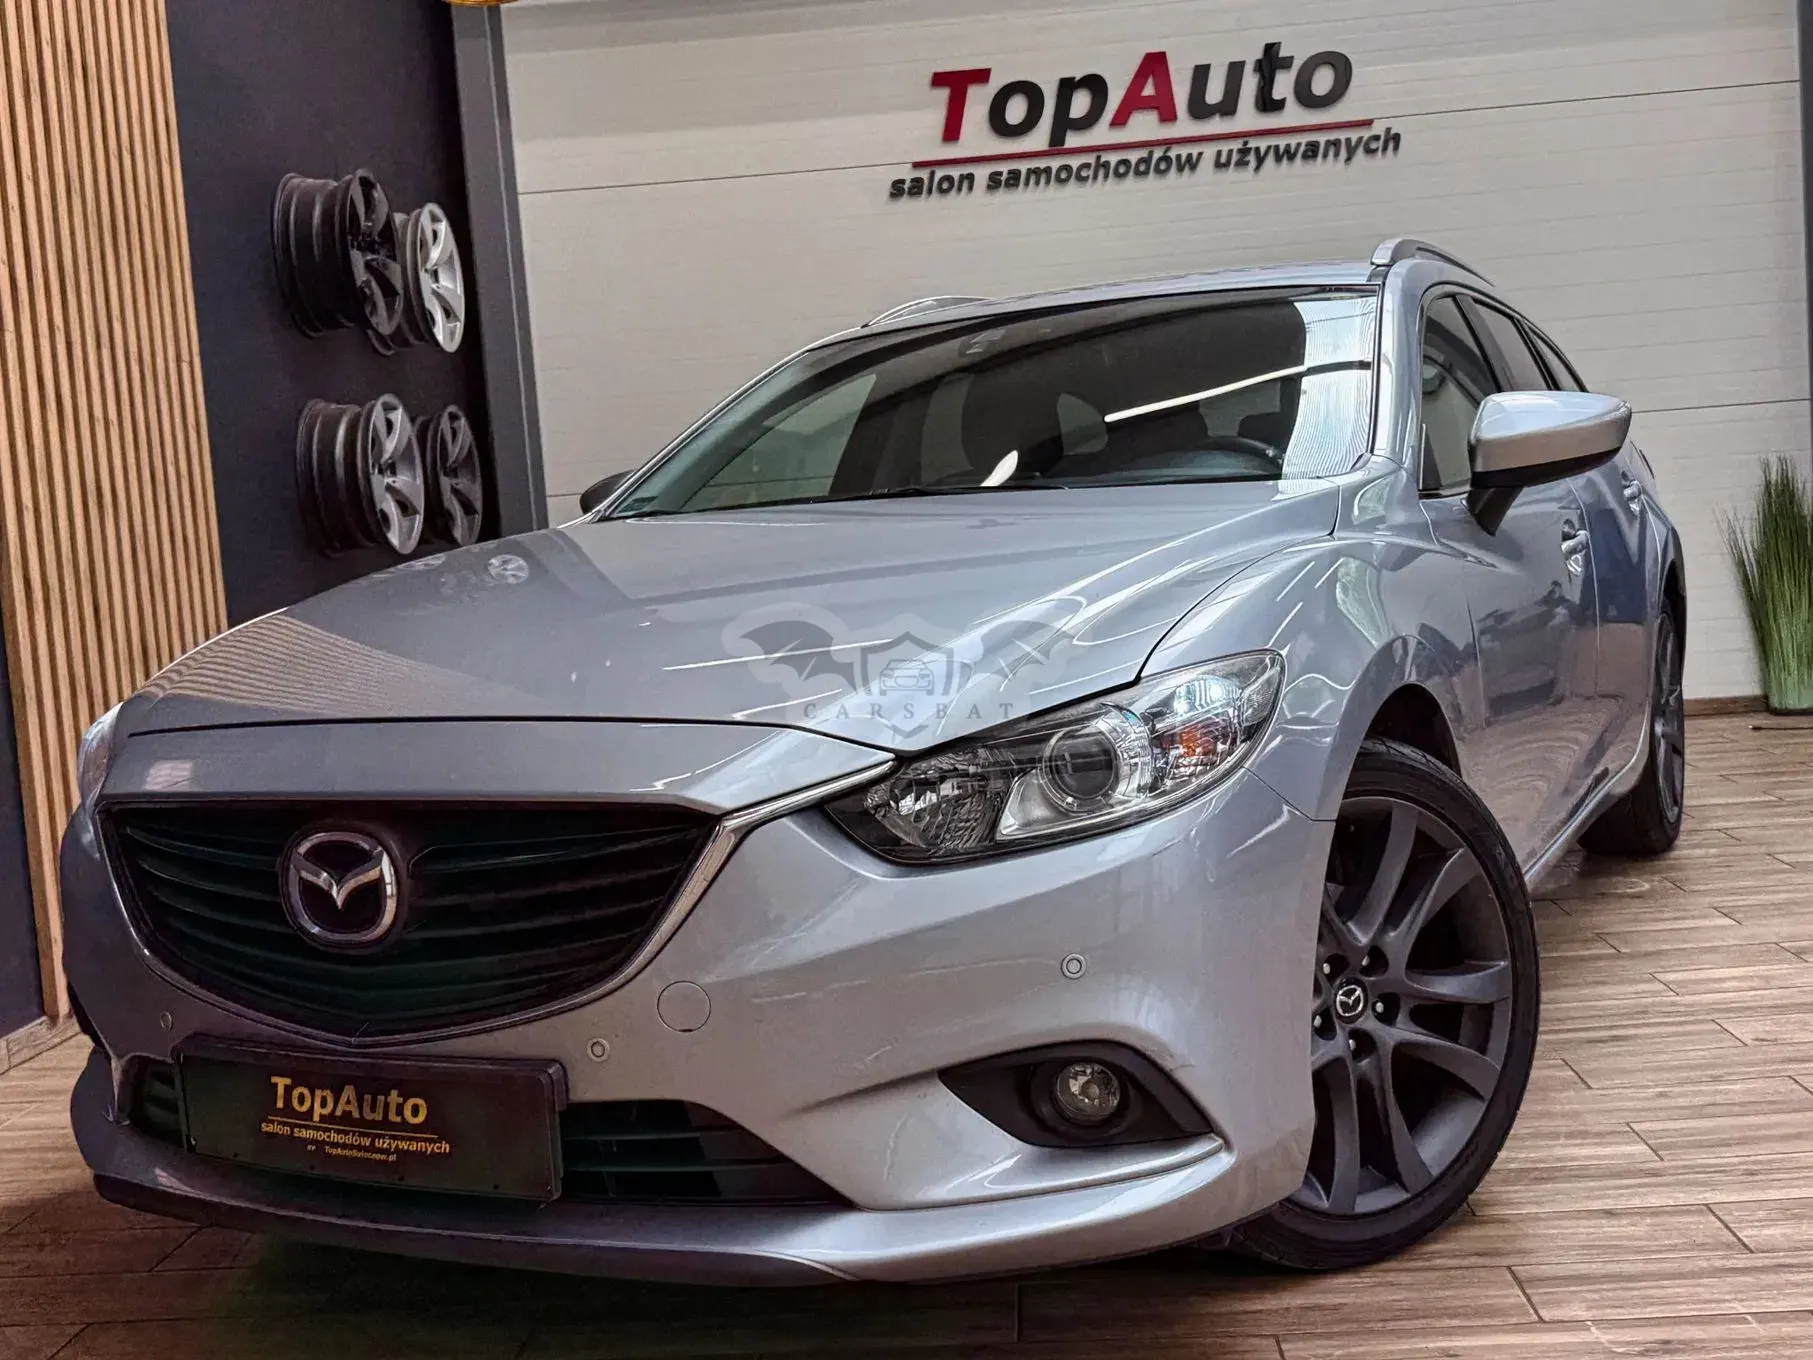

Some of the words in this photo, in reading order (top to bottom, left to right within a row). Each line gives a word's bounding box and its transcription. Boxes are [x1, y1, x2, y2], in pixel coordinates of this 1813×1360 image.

[930, 41, 1353, 148] TopAuto
[889, 169, 976, 199] salon
[986, 146, 1204, 193] samochodów
[1213, 126, 1402, 172] używanych
[270, 1075, 428, 1125] TopAuto
[261, 1120, 291, 1136] salon
[293, 1125, 372, 1147] samochodów
[374, 1136, 450, 1155] używanych
